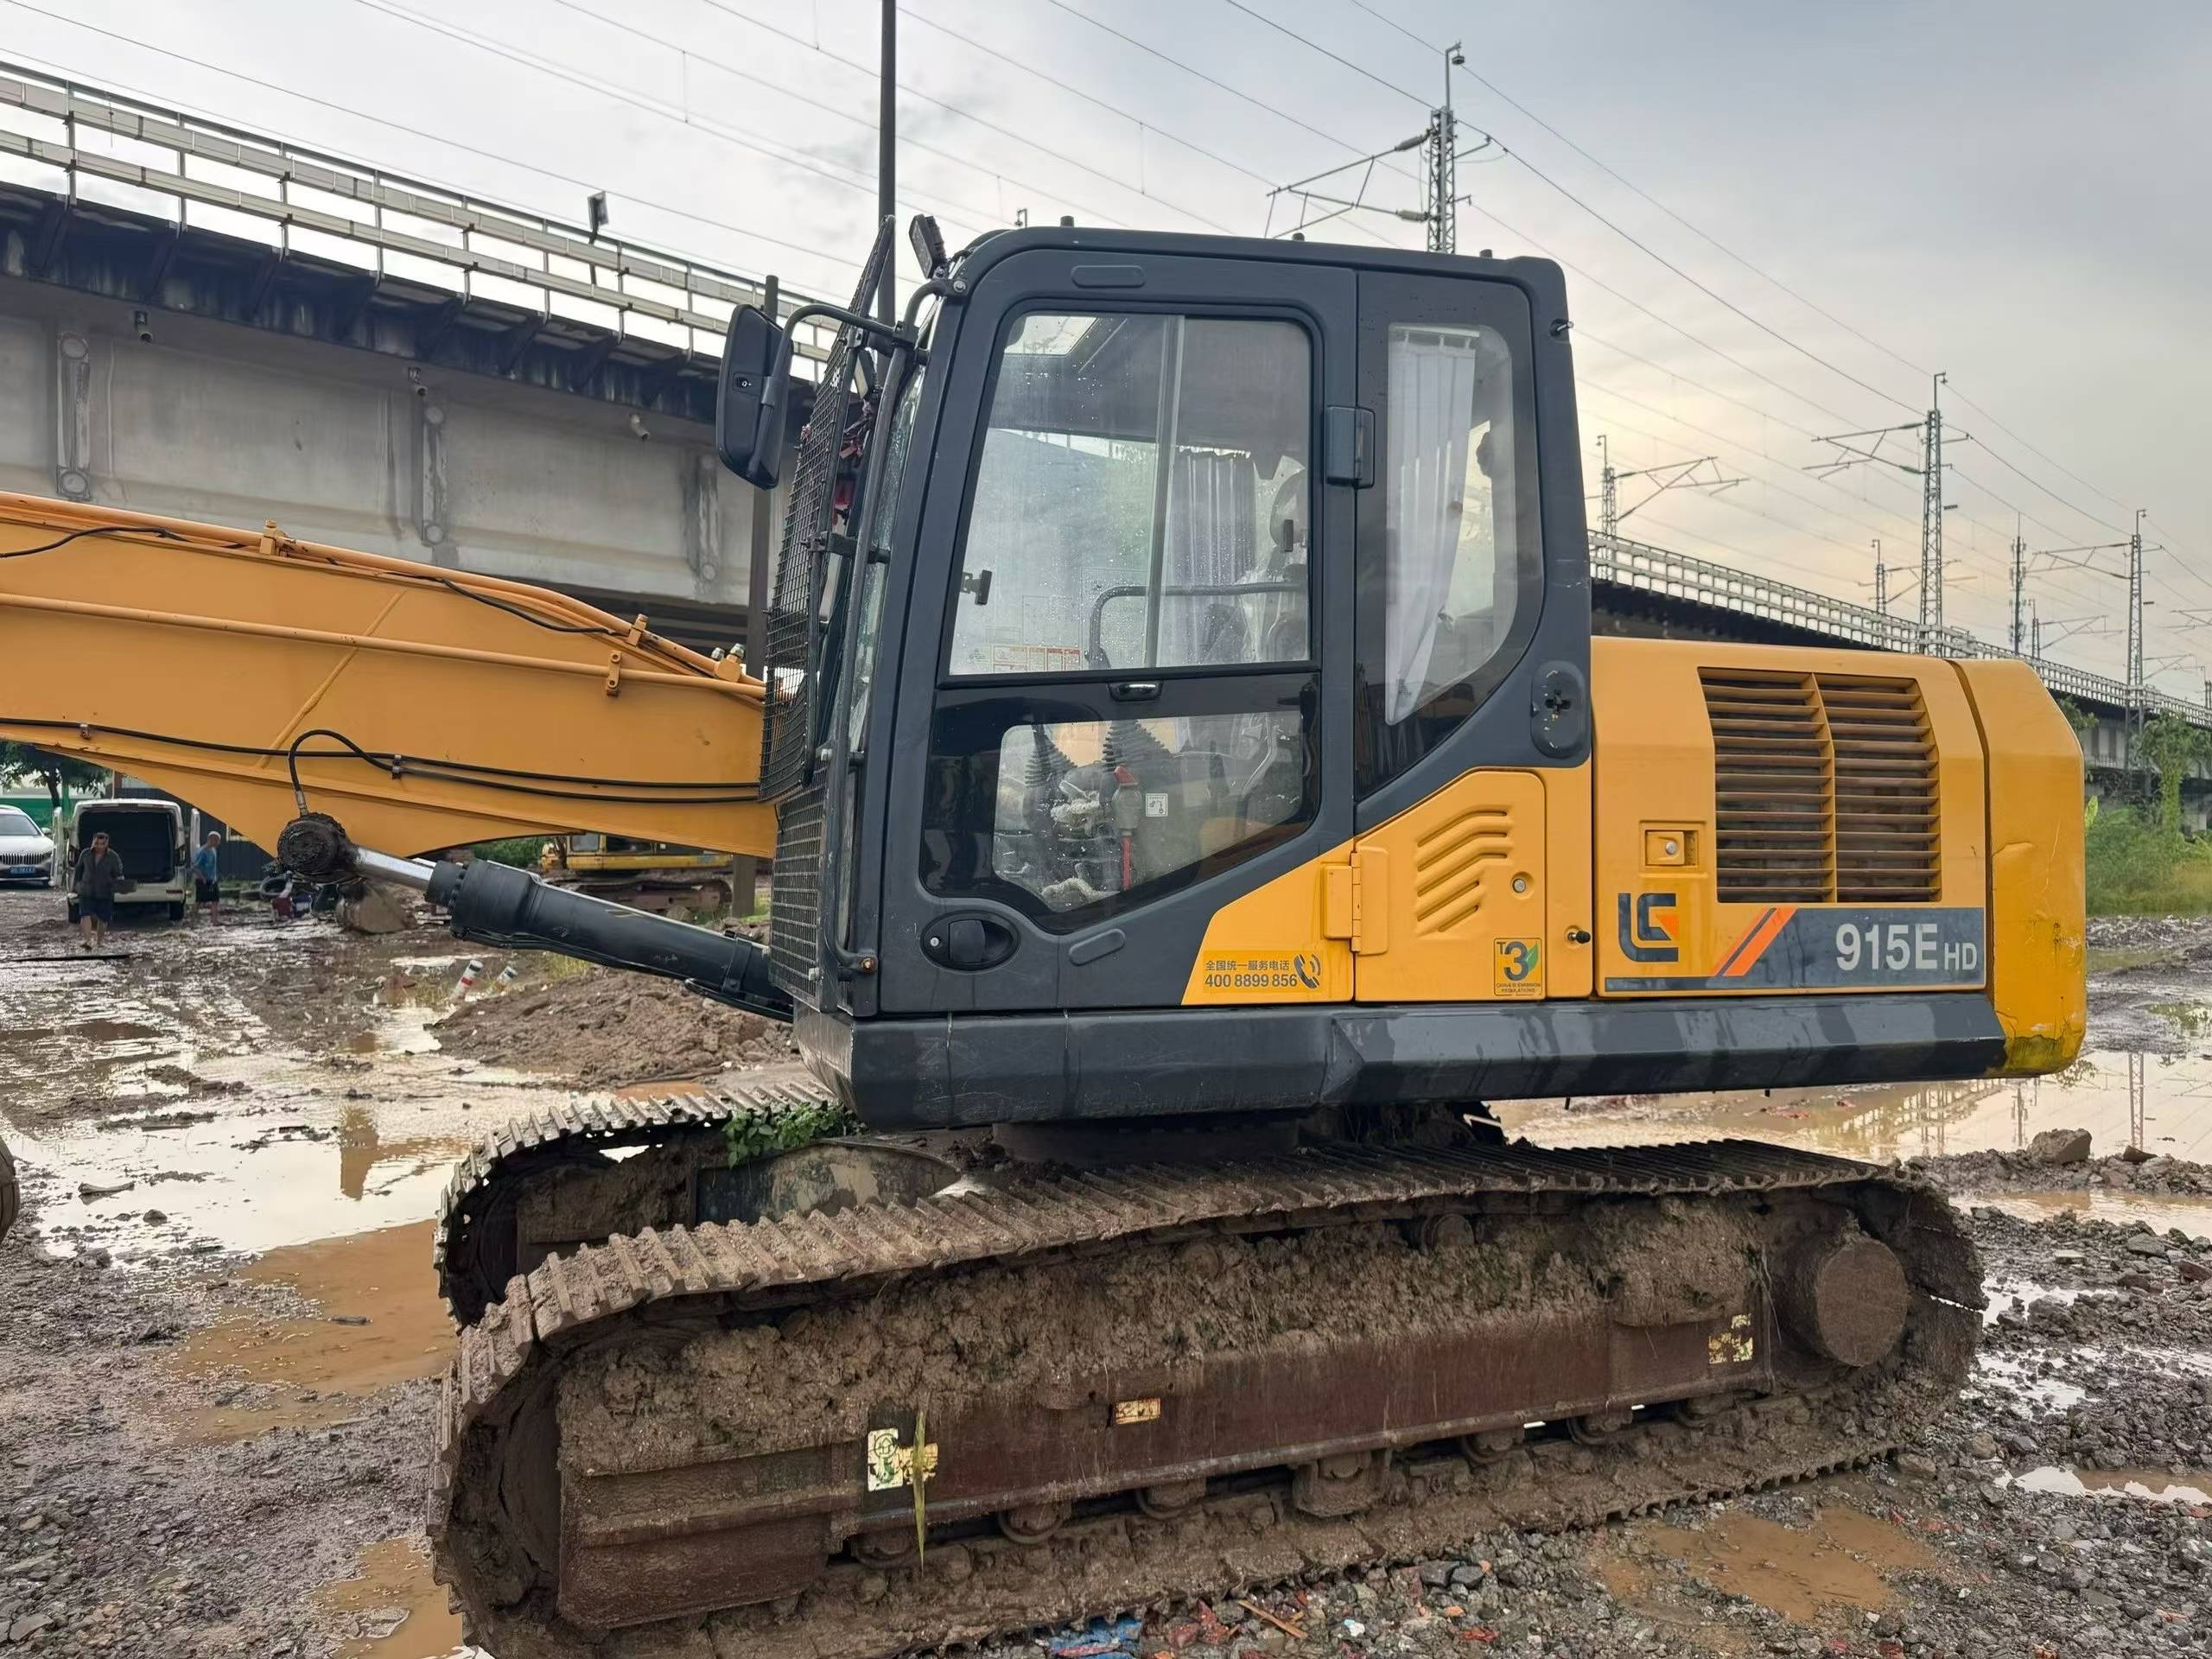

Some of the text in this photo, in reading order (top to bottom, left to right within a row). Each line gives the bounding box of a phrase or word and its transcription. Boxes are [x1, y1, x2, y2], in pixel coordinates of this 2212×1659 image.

[1835, 923, 1978, 971] 915E HD
[1205, 960, 1290, 971] 全国统一服务电话
[1205, 974, 1298, 988] 400 8899 856
